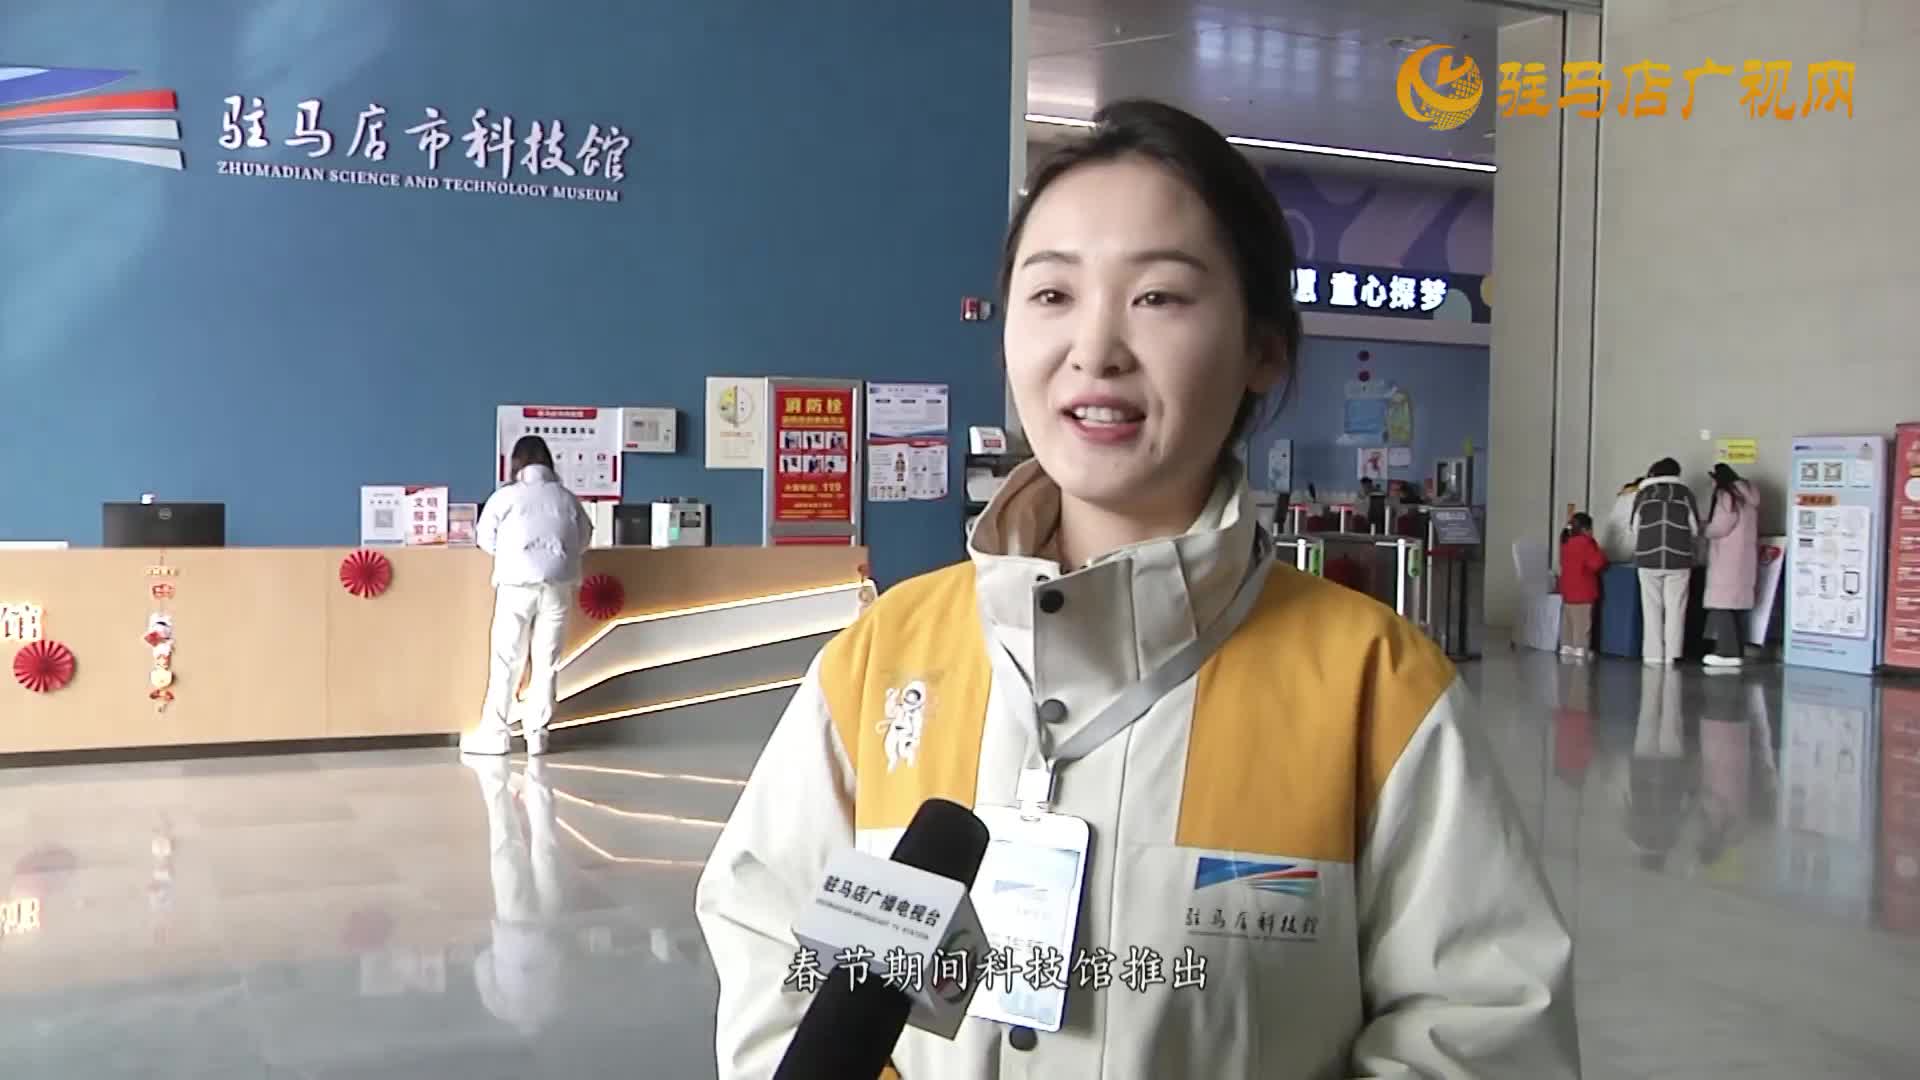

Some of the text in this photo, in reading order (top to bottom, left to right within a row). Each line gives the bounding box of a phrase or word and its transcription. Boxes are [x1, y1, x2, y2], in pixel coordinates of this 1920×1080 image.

[219, 95, 630, 183] 驻马店市科技馆
[216, 161, 619, 202] ZHUMADIAN SCIENCE AND TECHNOLOGY MUSEUM
[823, 874, 942, 927] 驻马店广播电视台
[1185, 907, 1319, 936] 驻马店科技馆
